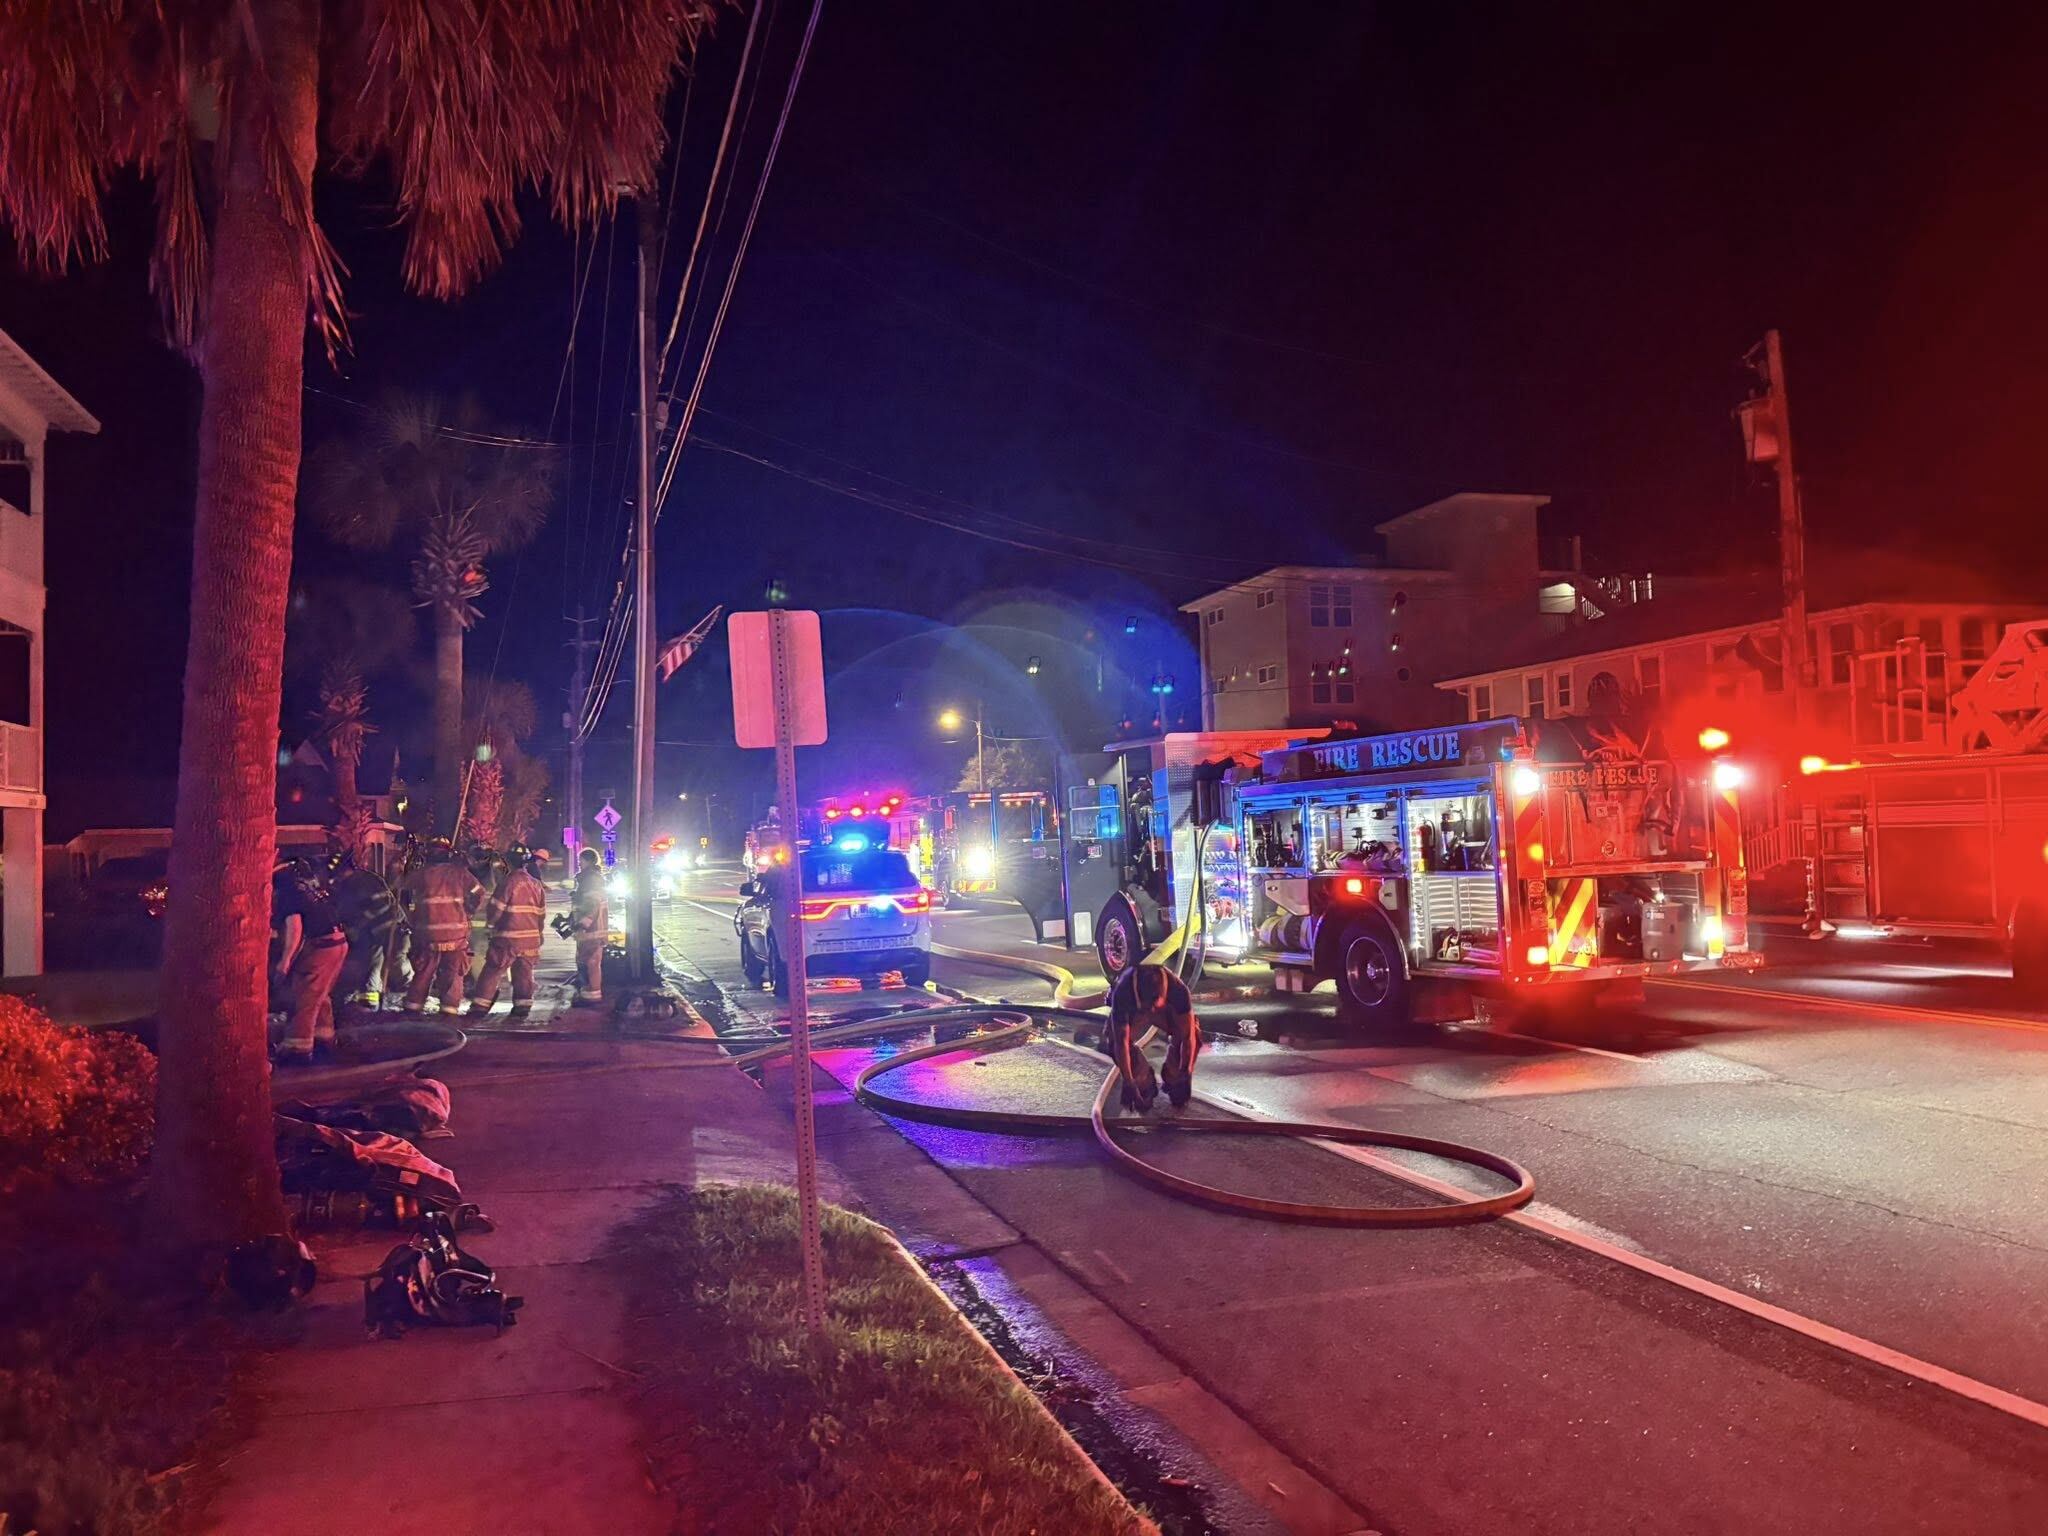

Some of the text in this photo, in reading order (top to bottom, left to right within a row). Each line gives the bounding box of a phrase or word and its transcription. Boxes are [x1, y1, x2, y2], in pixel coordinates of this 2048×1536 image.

[1313, 744, 1359, 772] FIRE
[1371, 732, 1460, 768] RESCUE
[1548, 767, 1659, 786] FIRE RESCUE
